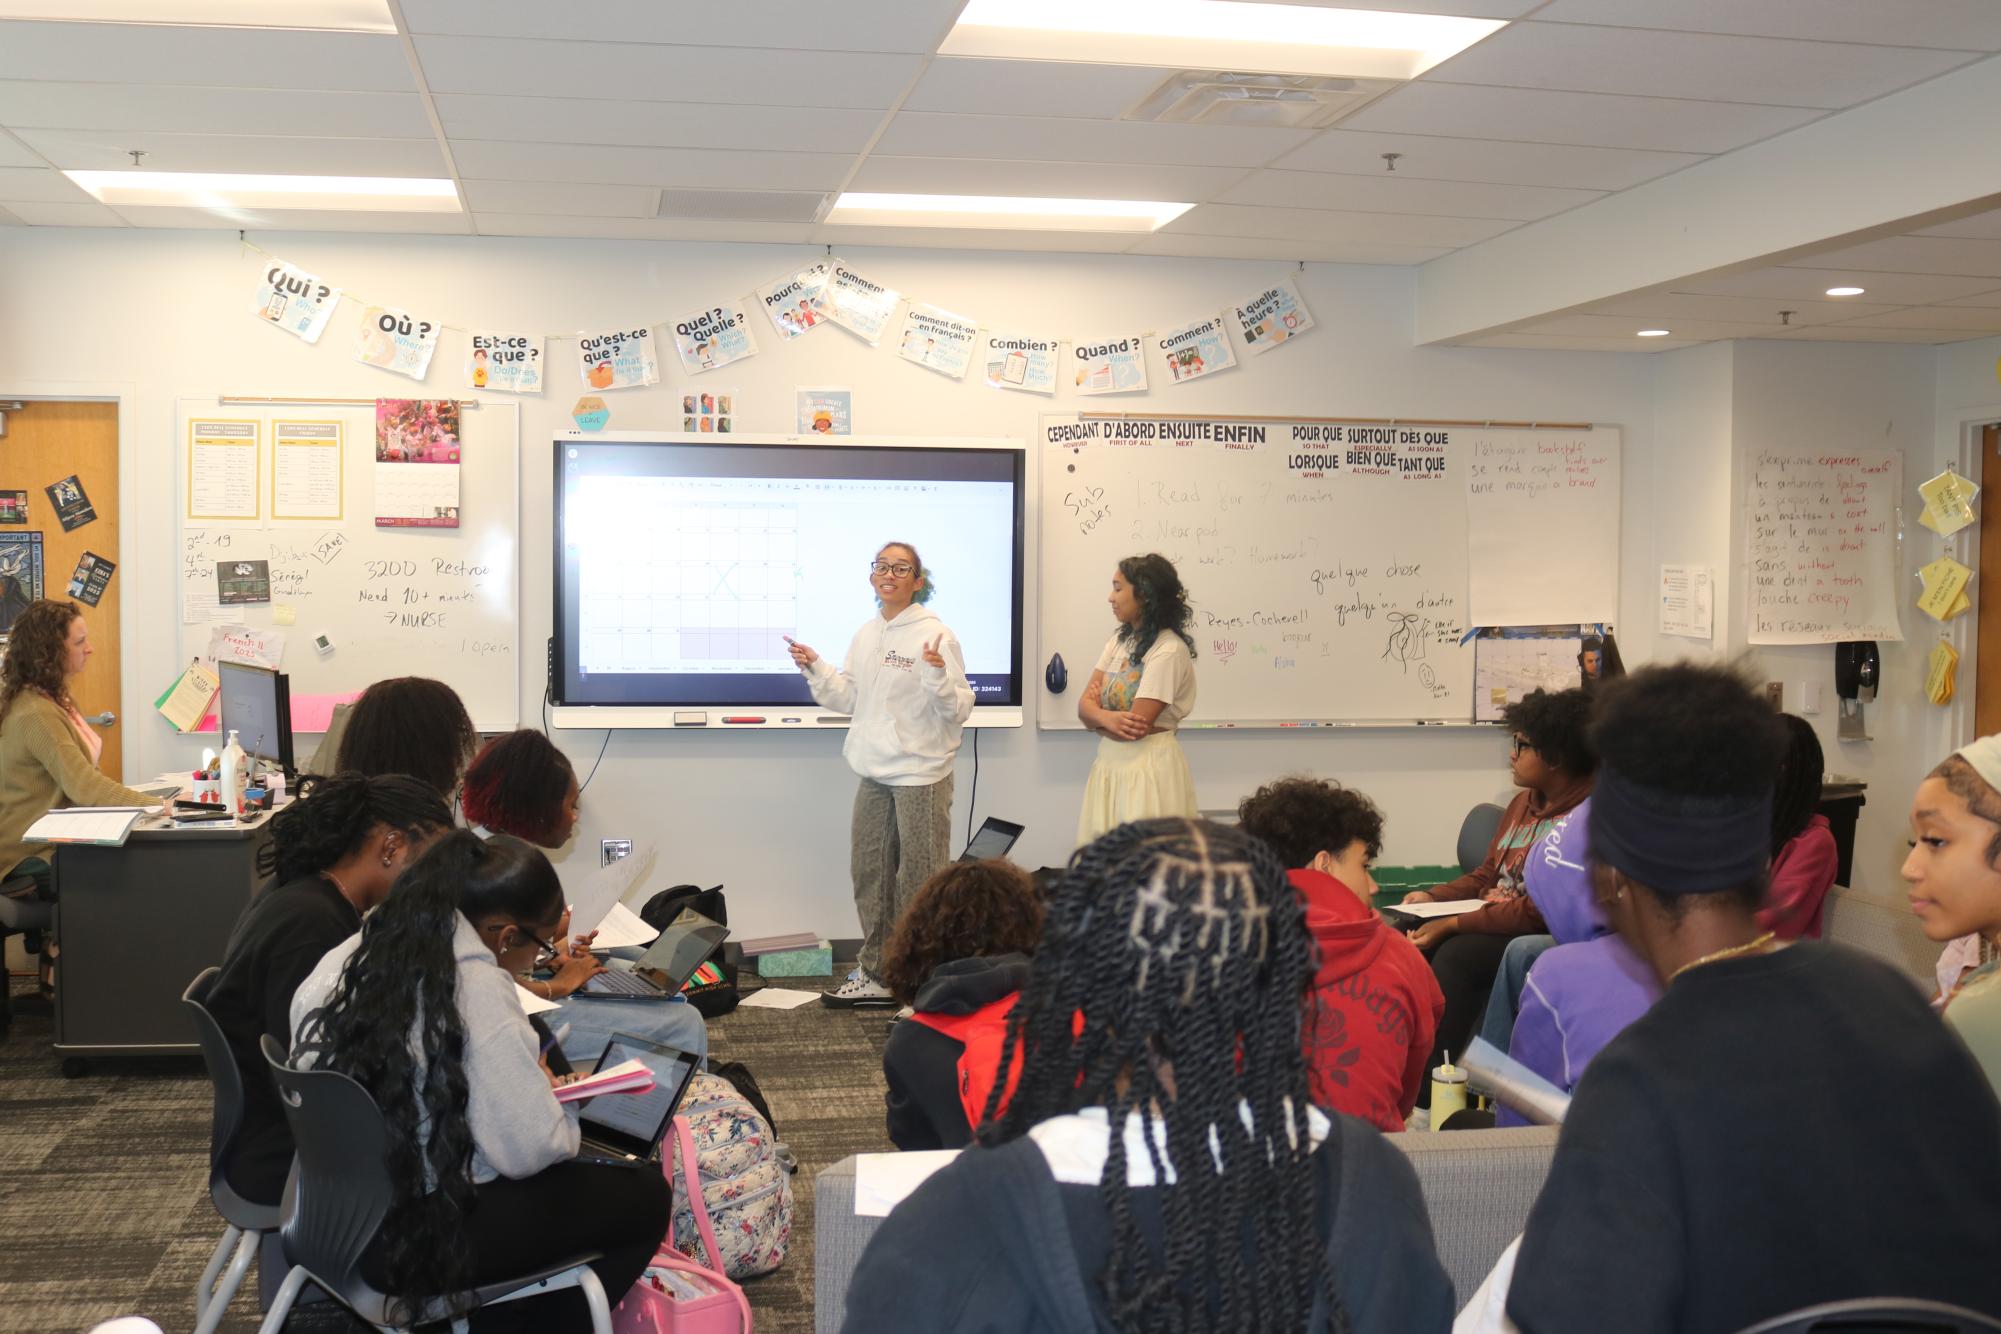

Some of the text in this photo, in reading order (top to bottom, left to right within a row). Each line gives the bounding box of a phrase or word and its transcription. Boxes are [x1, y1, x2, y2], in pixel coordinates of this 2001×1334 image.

[267, 266, 331, 304] Qui ?
[836, 267, 885, 294] Comment
[1245, 286, 1280, 316] quelle
[378, 314, 432, 339] Où ?
[676, 308, 722, 336] Quel ?
[909, 311, 976, 335] Comment dit-on
[1241, 305, 1275, 330] heure
[693, 313, 744, 342] Quelle ?
[918, 324, 930, 332] en
[930, 324, 965, 343] français
[1159, 318, 1222, 350] Comment ?
[473, 336, 528, 349] Est-ce
[580, 328, 648, 351] Qu'est-ce
[989, 338, 1058, 352] Combien ?
[492, 348, 539, 365] que ?
[583, 345, 621, 365] que ?
[1075, 338, 1140, 360] Quand ?
[1047, 422, 1100, 443] CEPENDANT
[1103, 422, 1156, 439] D'ABORD
[1159, 422, 1211, 440] ENSUITE
[1213, 425, 1266, 443] ENFIN
[1292, 426, 1343, 443] POUR QUE
[1347, 428, 1397, 444] SURTOUT
[1400, 428, 1449, 445] DÈS QUE
[1225, 443, 1255, 451] FINALLY
[1288, 454, 1339, 471] LORSQUE
[1346, 451, 1397, 467] BIEN QUE
[1398, 457, 1446, 473] TANT QUE
[1352, 467, 1390, 475] ALTHOUGH
[1471, 464, 1488, 478] se
[1471, 482, 1495, 494] une
[1064, 486, 1105, 516] Sub
[1080, 504, 1113, 535] notes
[215, 535, 231, 548] 19
[1757, 526, 1776, 539] sur
[318, 536, 343, 558] SAVE
[364, 560, 417, 580] 3200
[1755, 559, 1787, 572] sans
[1311, 559, 1423, 595] quelque chose
[359, 588, 389, 602] Need
[401, 611, 448, 628] NURSE
[223, 633, 255, 648] French
